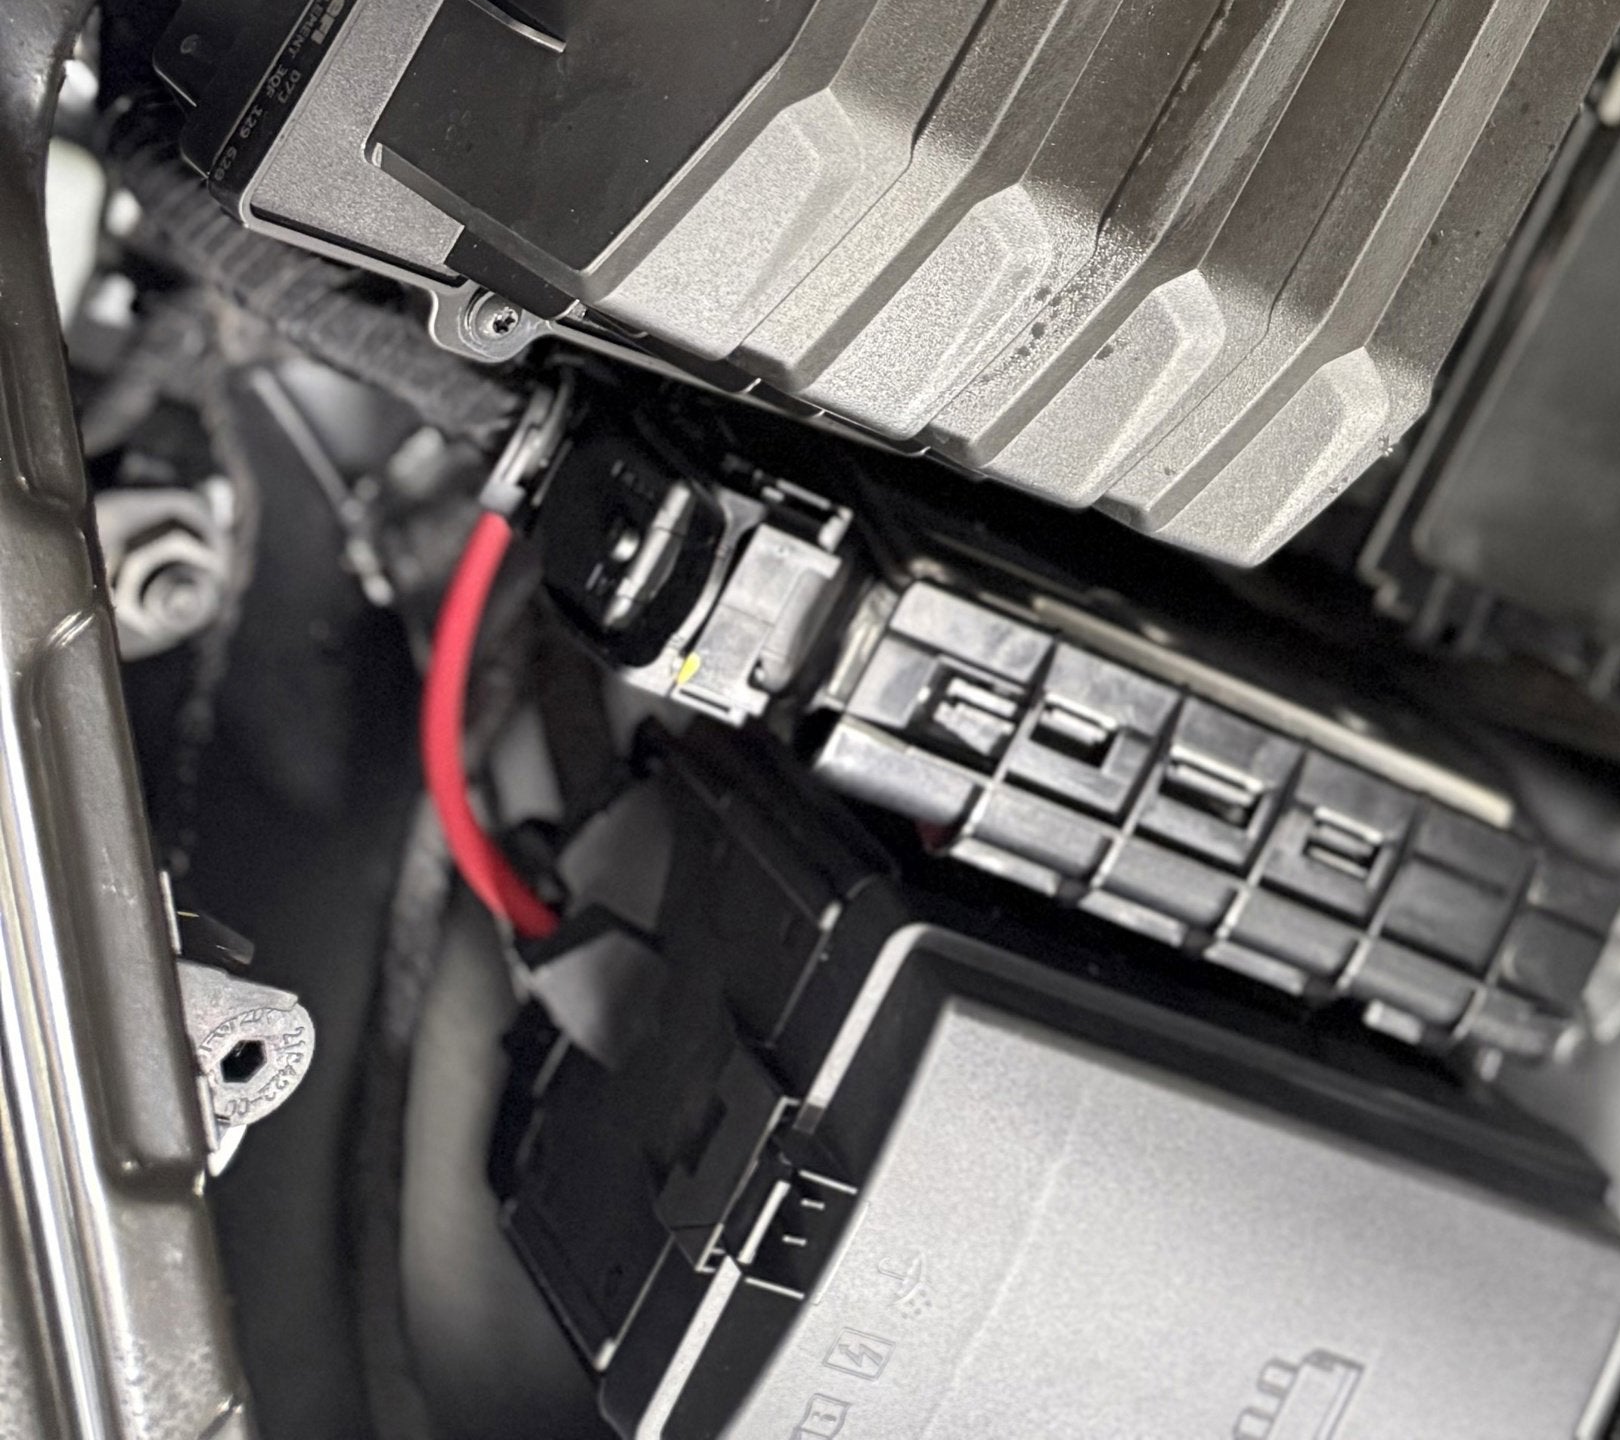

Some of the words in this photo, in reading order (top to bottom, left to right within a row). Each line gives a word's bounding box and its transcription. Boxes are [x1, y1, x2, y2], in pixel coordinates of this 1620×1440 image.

[264, 64, 289, 98] 3QF
[239, 105, 264, 139] 129
[213, 146, 238, 181] 620
